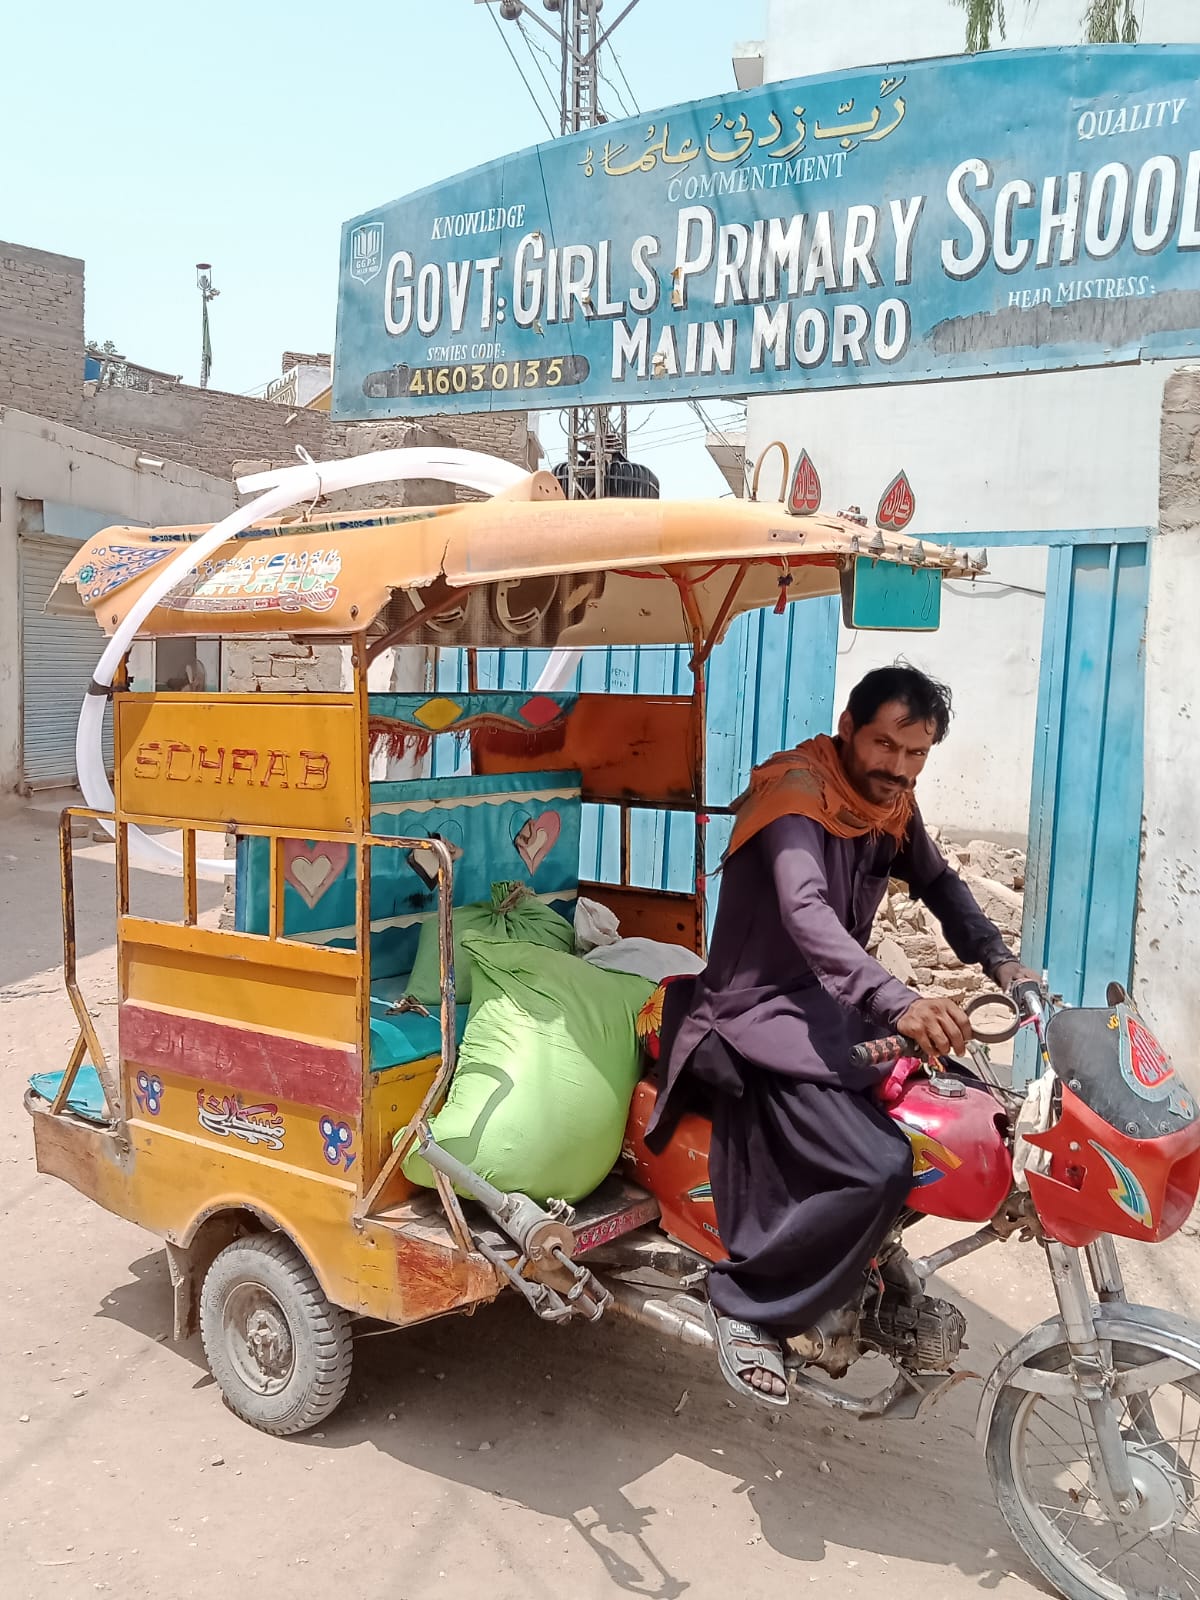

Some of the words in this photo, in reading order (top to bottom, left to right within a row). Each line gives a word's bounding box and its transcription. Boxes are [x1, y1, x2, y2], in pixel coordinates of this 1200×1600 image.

[1077, 98, 1187, 140] QUALITY
[667, 152, 847, 202] COMMENTMENT
[431, 204, 525, 240] KNOWLEDGE
[513, 231, 661, 329] GIRLS
[671, 195, 927, 311] PRIMARY
[1008, 289, 1051, 308] HEAD
[612, 318, 737, 382] MAIN
[750, 298, 911, 373] MORO
